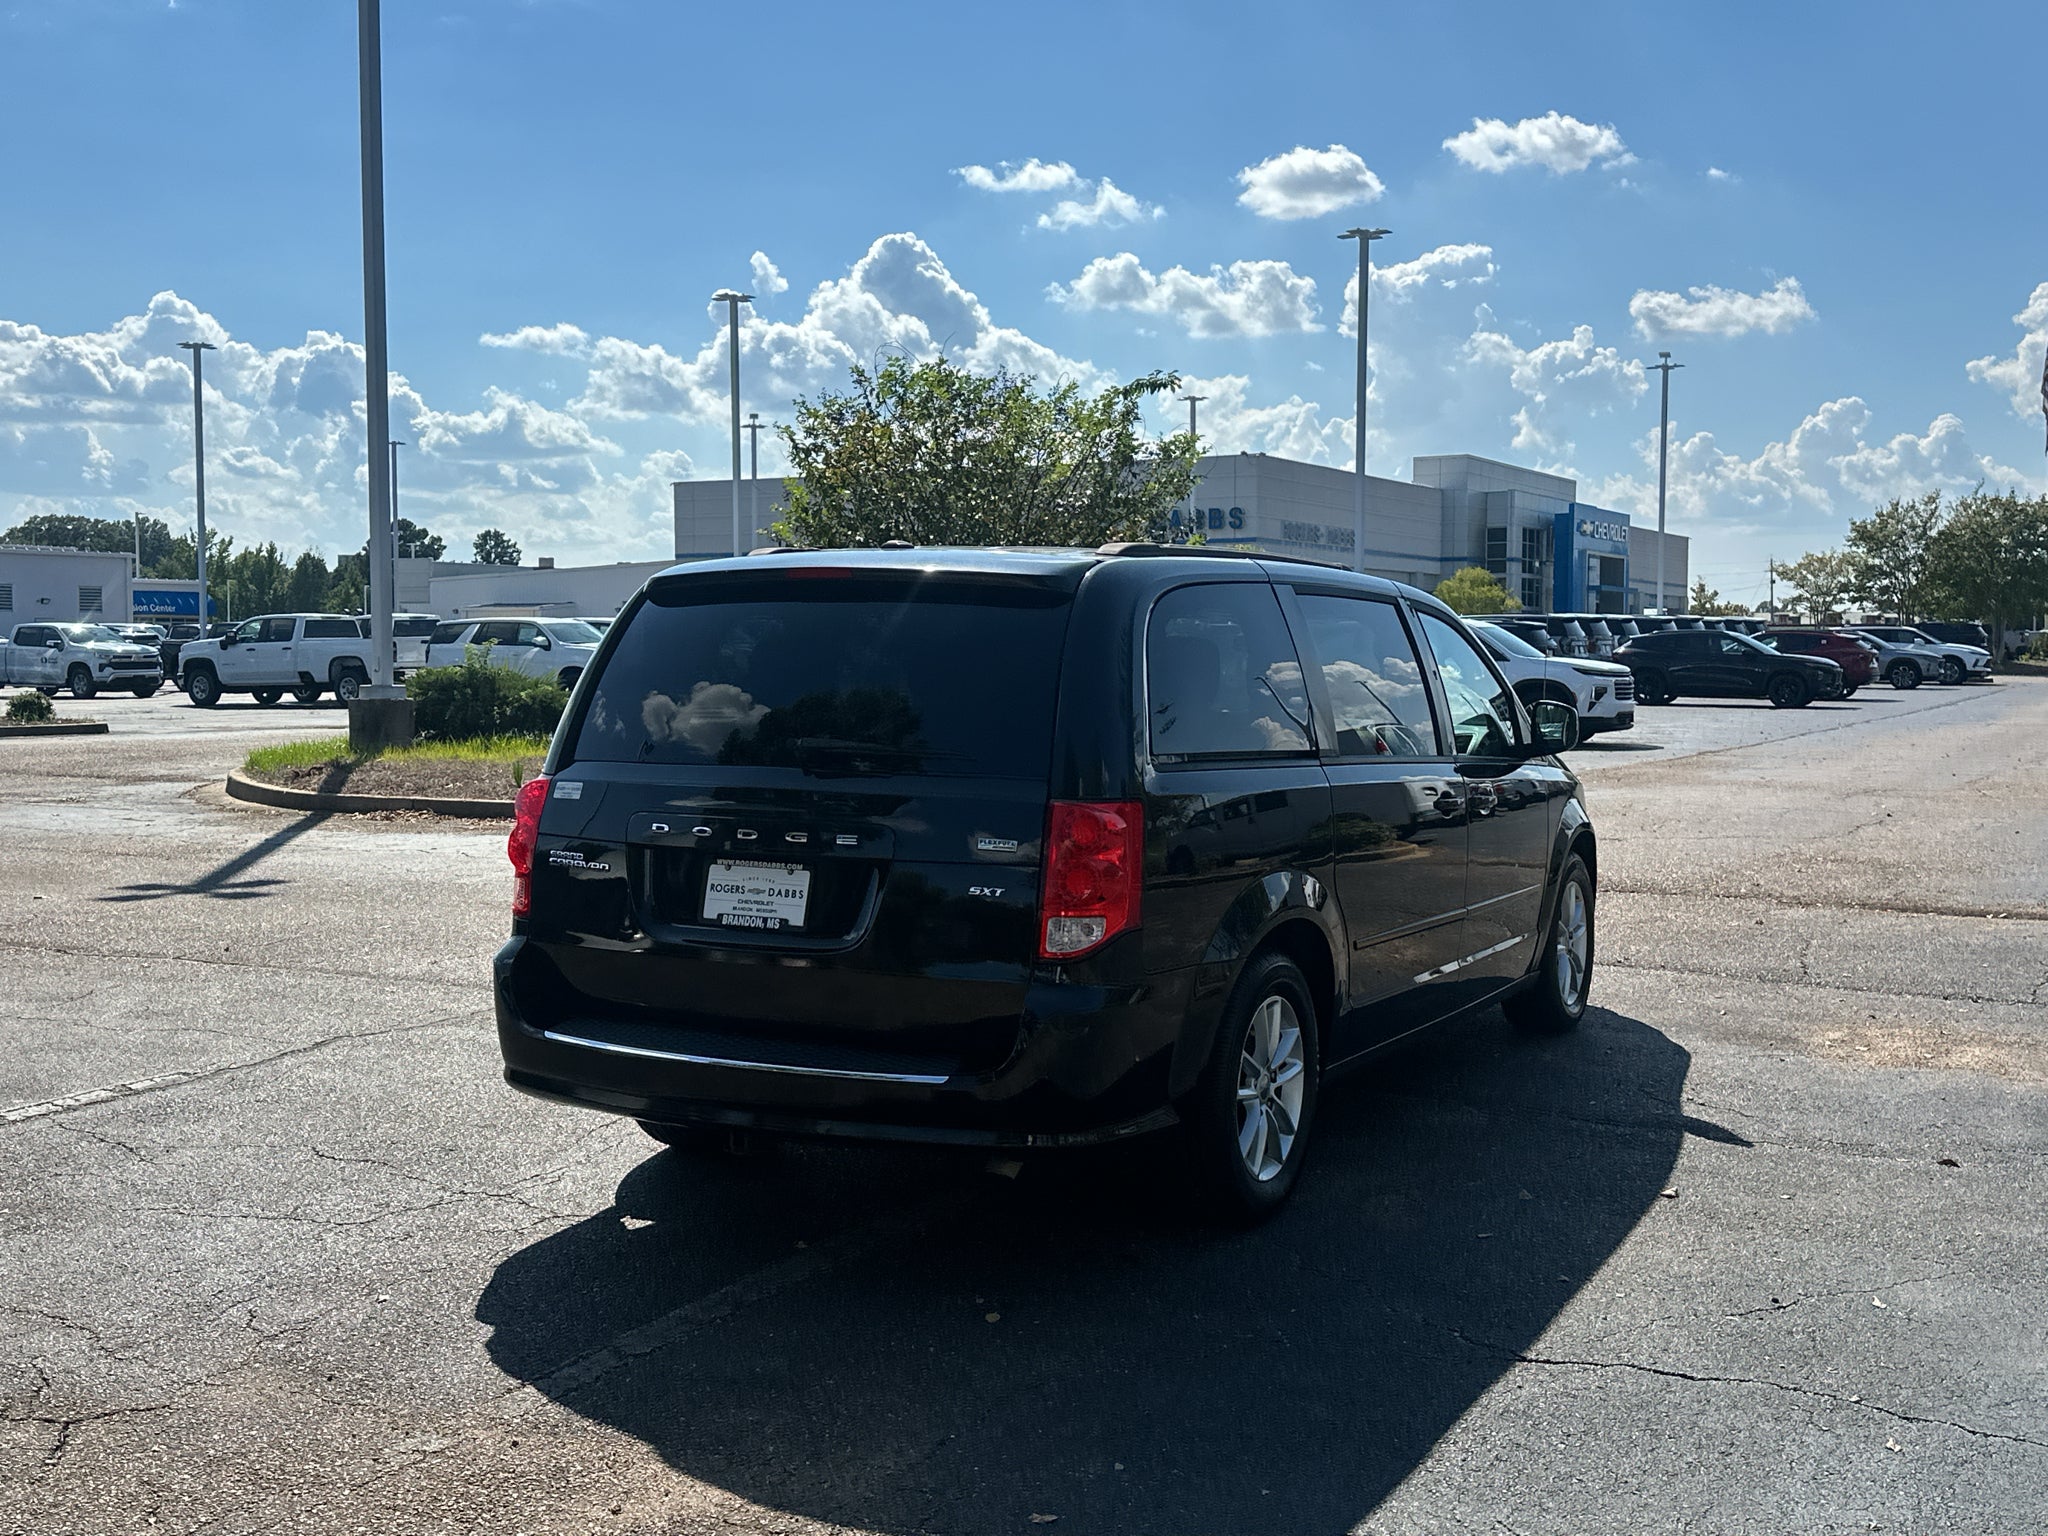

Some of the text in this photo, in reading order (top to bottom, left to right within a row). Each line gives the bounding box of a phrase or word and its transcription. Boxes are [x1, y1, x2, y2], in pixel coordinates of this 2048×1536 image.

[1170, 507, 1244, 530] ABBS
[1594, 521, 1628, 542] CHEVROLET
[149, 603, 176, 613] Center
[651, 823, 858, 845] DODGE
[549, 857, 609, 870] CARAVAN
[710, 883, 804, 899] ROGERS DABBS
[968, 886, 1006, 897] SXT
[721, 914, 780, 929] BRANDON, MS
